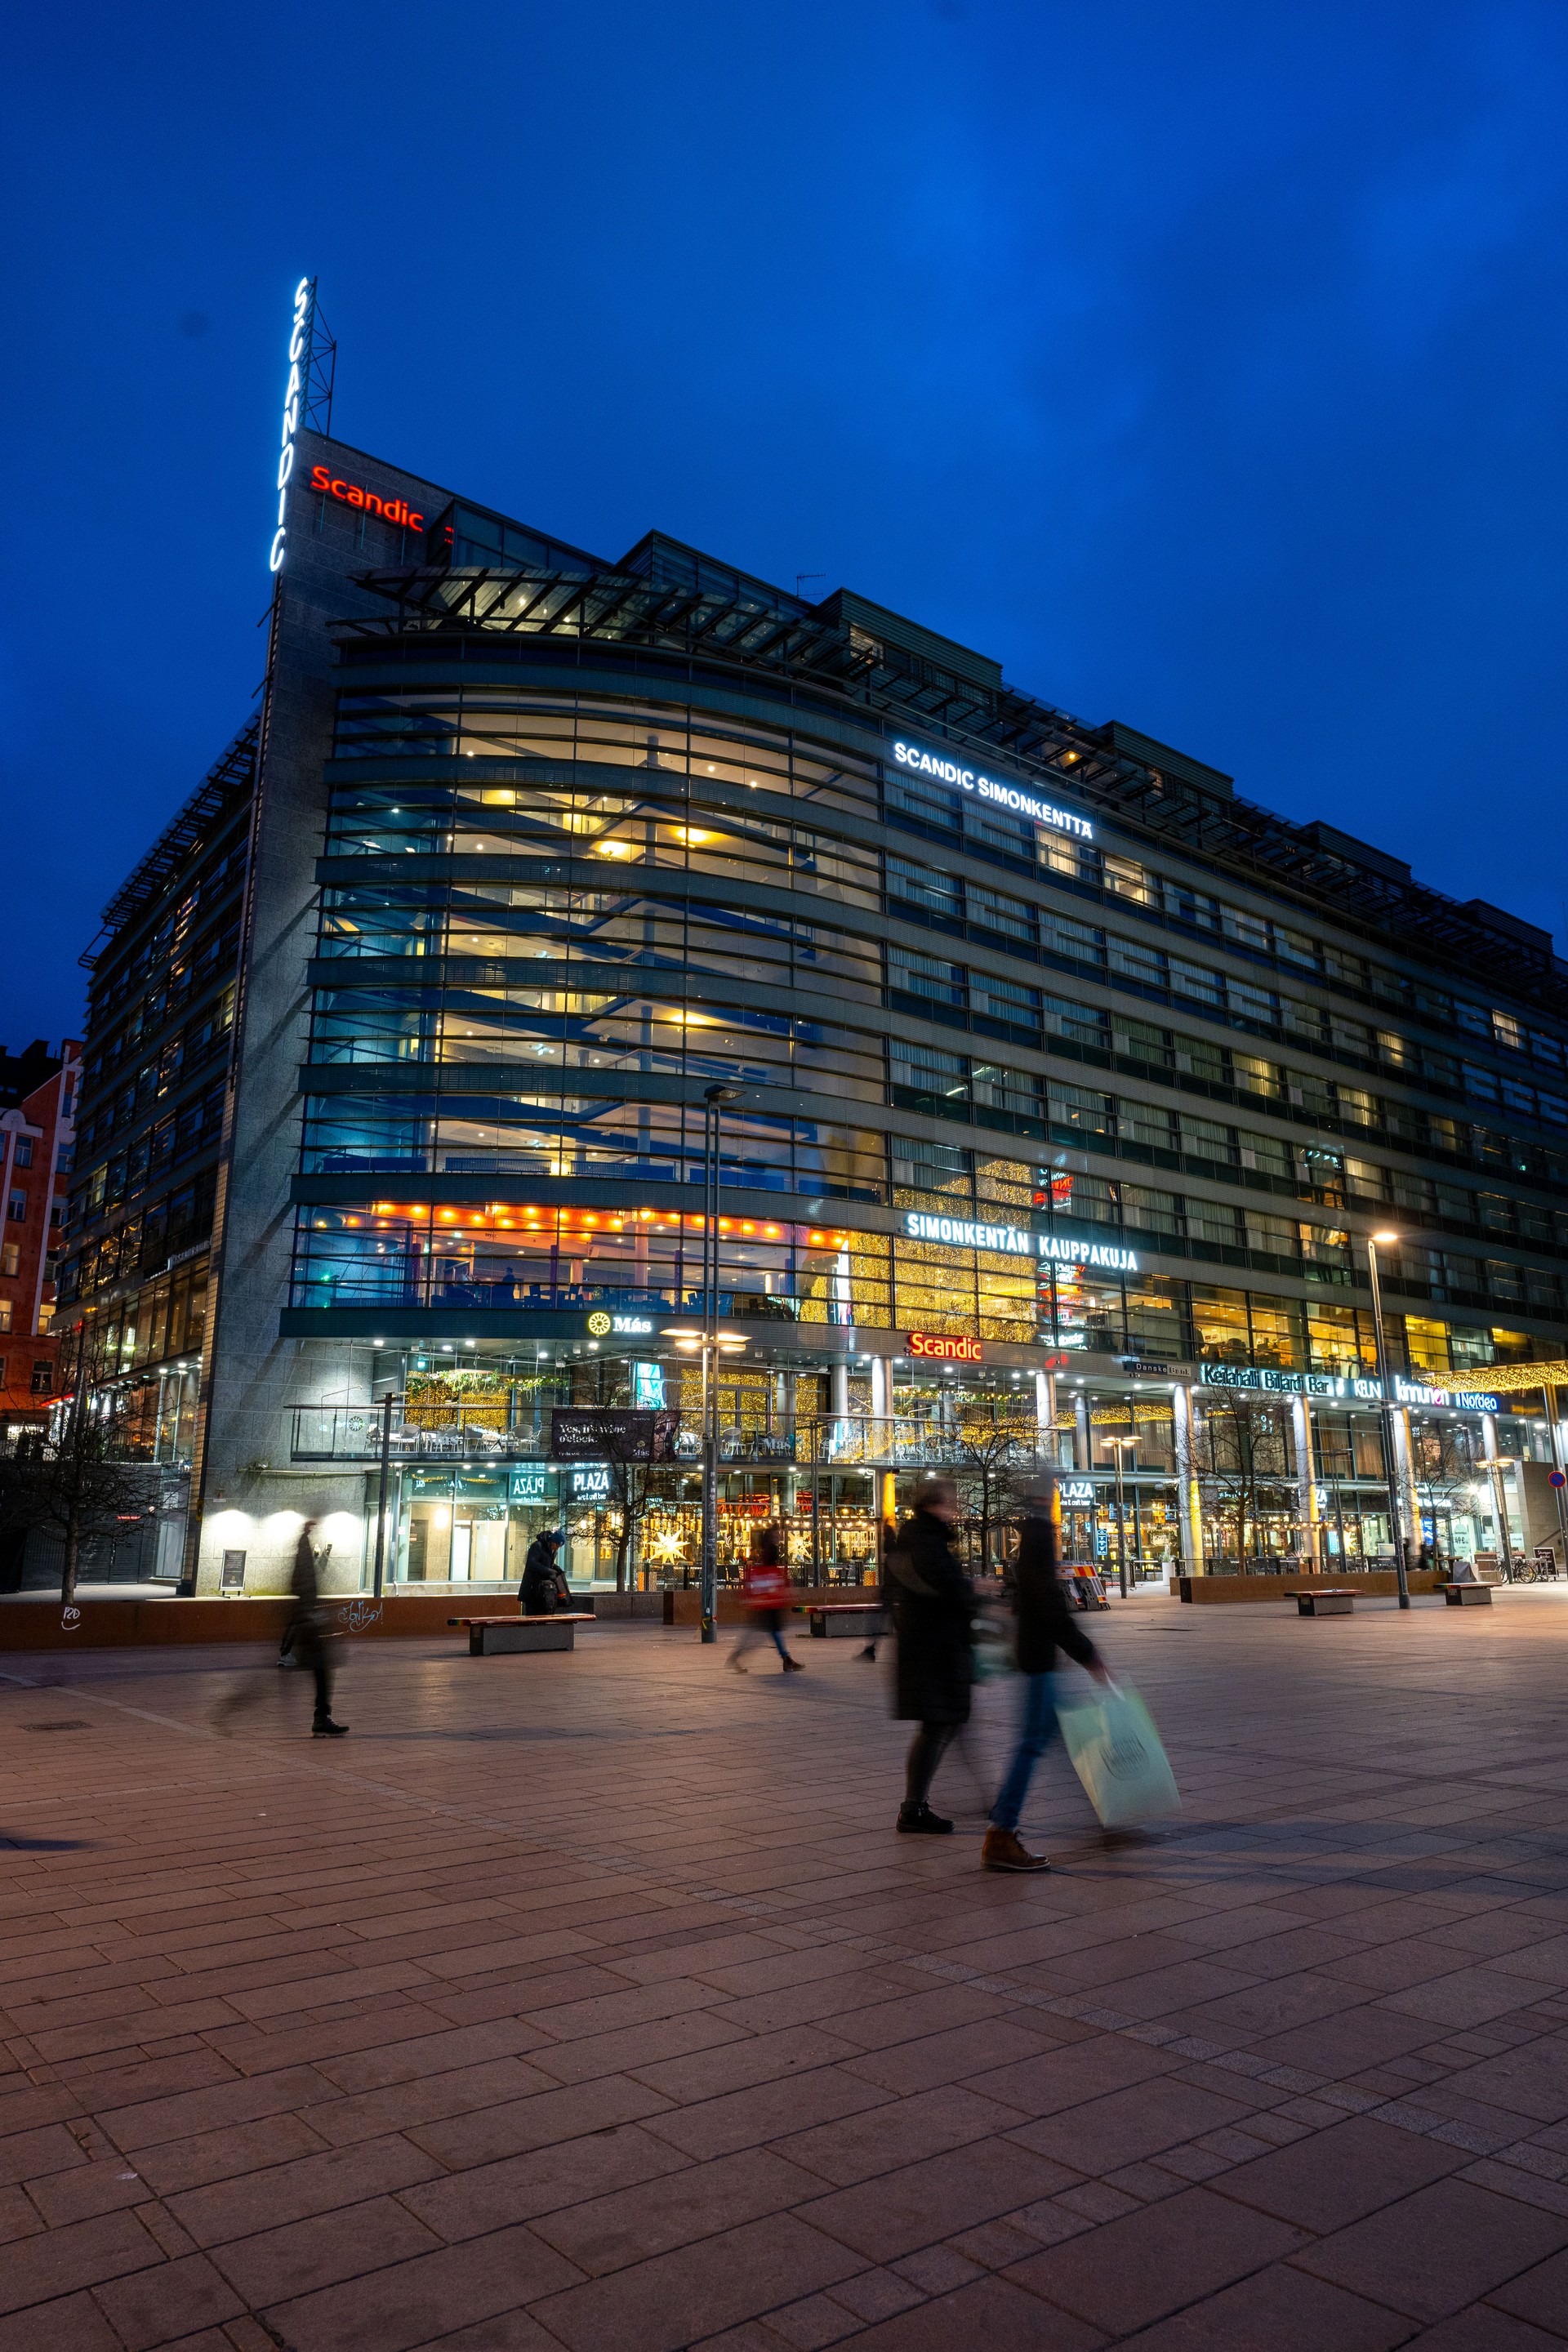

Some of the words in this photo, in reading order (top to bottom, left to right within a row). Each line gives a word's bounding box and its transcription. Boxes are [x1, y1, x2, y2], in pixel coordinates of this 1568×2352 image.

[270, 276, 310, 572] SCANDIC
[310, 465, 424, 533] Scandic
[894, 742, 975, 791] SCANDIC
[906, 1213, 1030, 1254] SIMONKENTÄN
[1039, 1235, 1138, 1271] KAUPPAKUJA
[612, 1316, 653, 1333] Más
[910, 1331, 982, 1360] Scandic
[1136, 1363, 1167, 1373] Danske
[1170, 1366, 1192, 1376] Bank
[1203, 1364, 1260, 1388] Keilahalli
[1308, 1376, 1330, 1394] Bar
[1394, 1374, 1450, 1406] kinnunen
[1461, 1392, 1498, 1411] Nordea
[559, 1424, 581, 1434] Yes,
[574, 1472, 609, 1492] PLAZA
